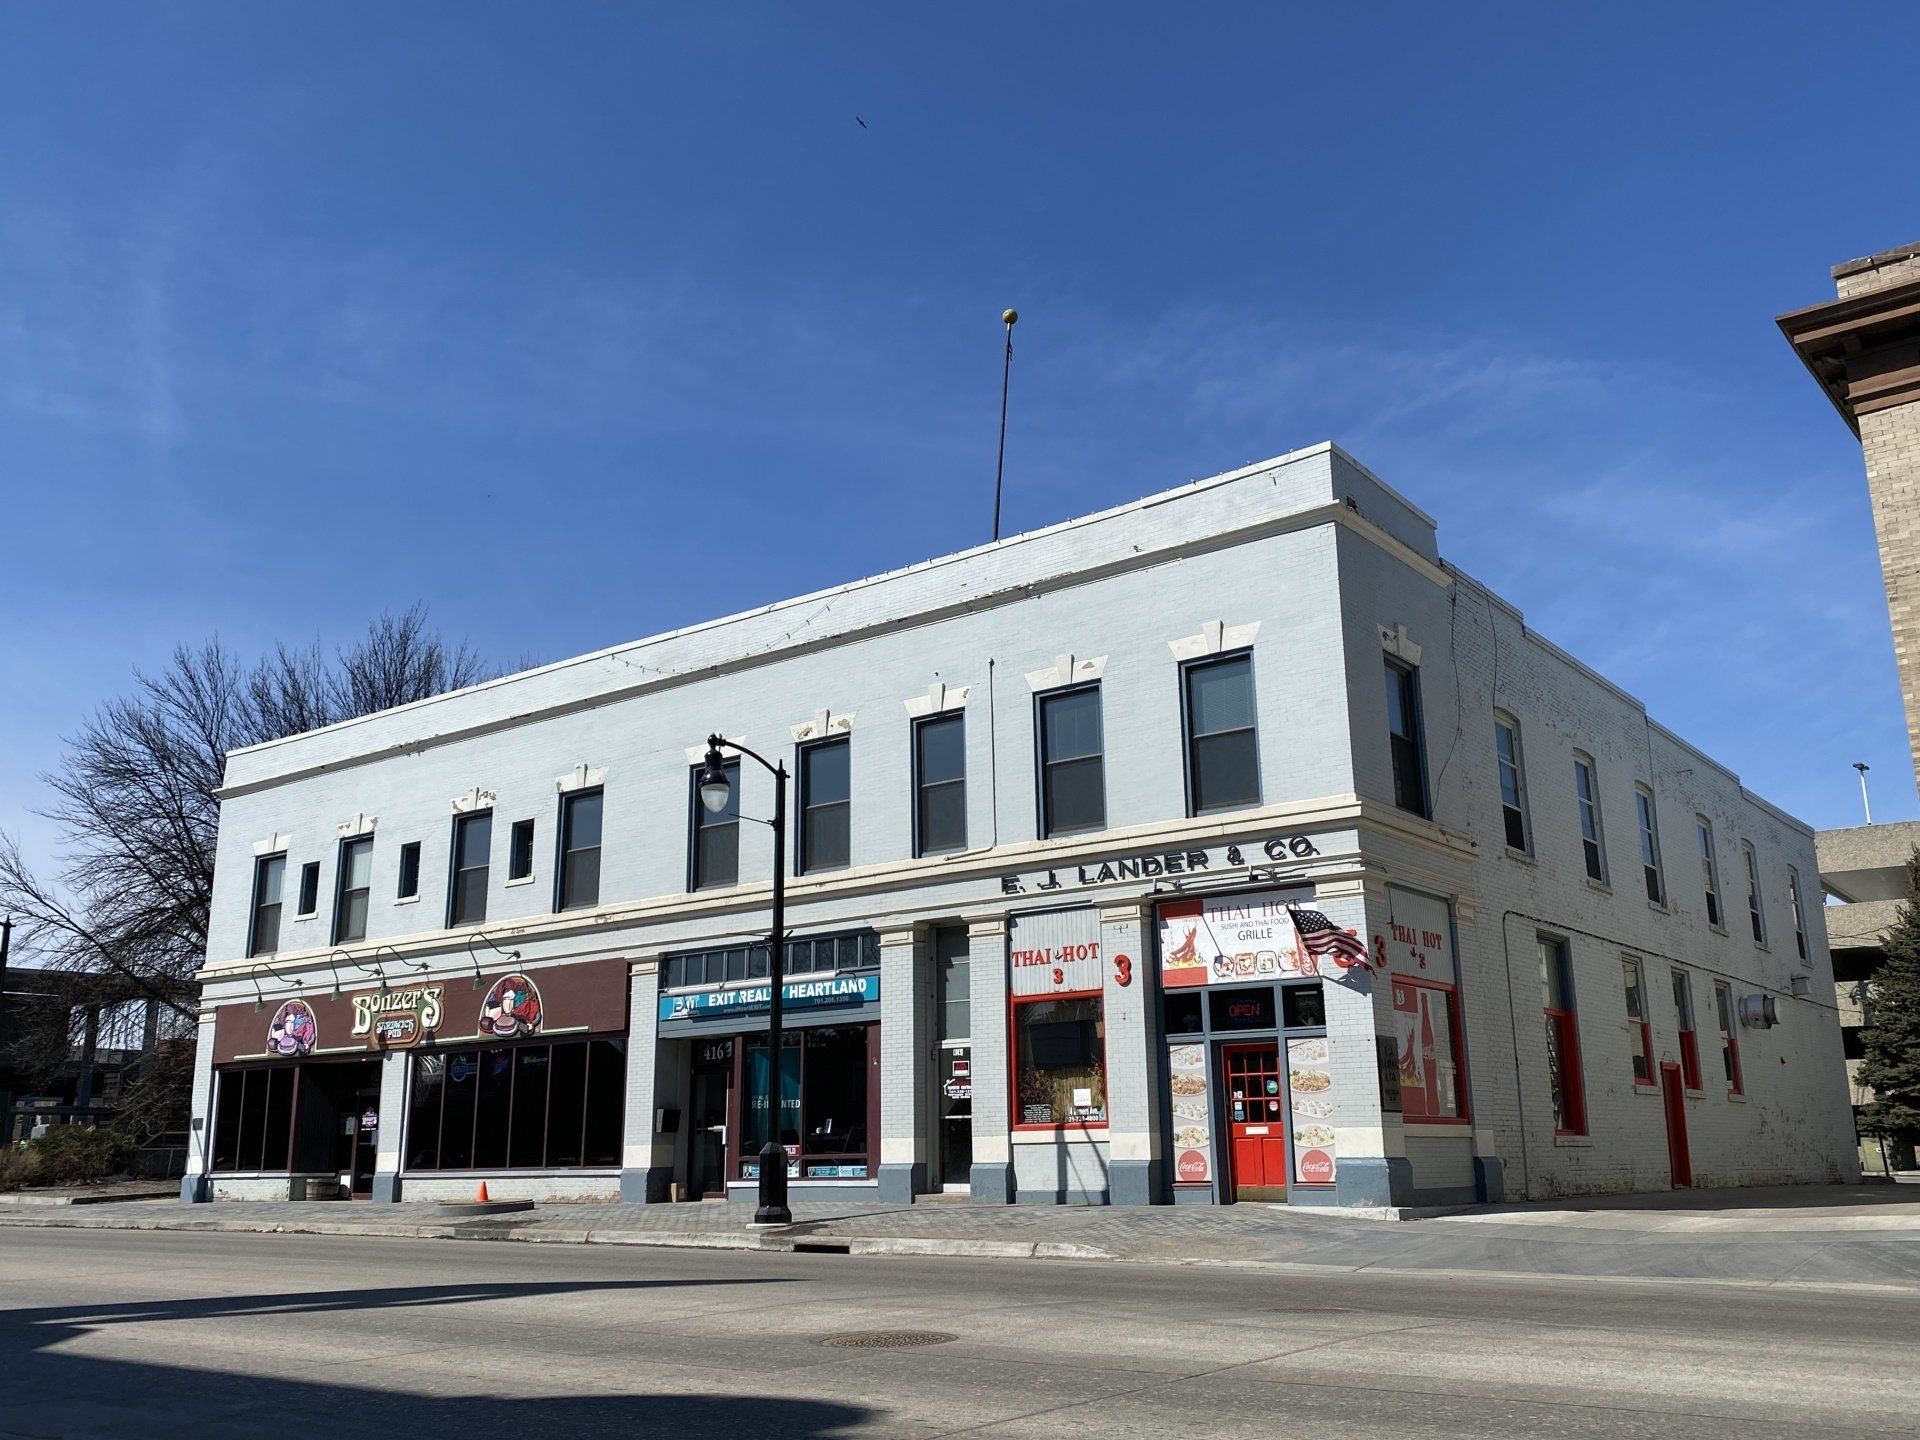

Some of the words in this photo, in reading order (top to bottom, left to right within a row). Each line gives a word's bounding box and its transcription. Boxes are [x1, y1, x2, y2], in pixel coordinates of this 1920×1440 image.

[1001, 875, 1025, 895] E.
[1037, 868, 1062, 890] J.
[1078, 850, 1209, 885] LANDER
[1227, 845, 1247, 866] &
[1208, 904, 1250, 922] THAI
[1262, 898, 1300, 917] HOT
[1221, 923, 1239, 931] SUSHI
[1240, 920, 1254, 929] AND
[1255, 919, 1269, 927] THAI
[1270, 917, 1289, 926] FOOD
[1238, 928, 1273, 941] GRILLE
[1391, 924, 1417, 946] THAI
[1422, 930, 1443, 950] HOT
[1012, 948, 1052, 968] THAI
[1062, 942, 1100, 963] HOT
[1374, 935, 1387, 968] 3
[1053, 968, 1064, 985] 3
[1114, 954, 1132, 987] 3
[709, 993, 736, 1006] EXIT
[739, 986, 786, 1004] REAL
[789, 978, 867, 999] HEARTLAND
[1229, 1003, 1261, 1017] OPEN
[387, 1028, 402, 1038] PUB
[704, 1043, 724, 1061] 416
[786, 1147, 797, 1155] OLD
[1180, 1161, 1205, 1172] Coca-Cola
[1303, 1161, 1330, 1173] Coca-Cola
